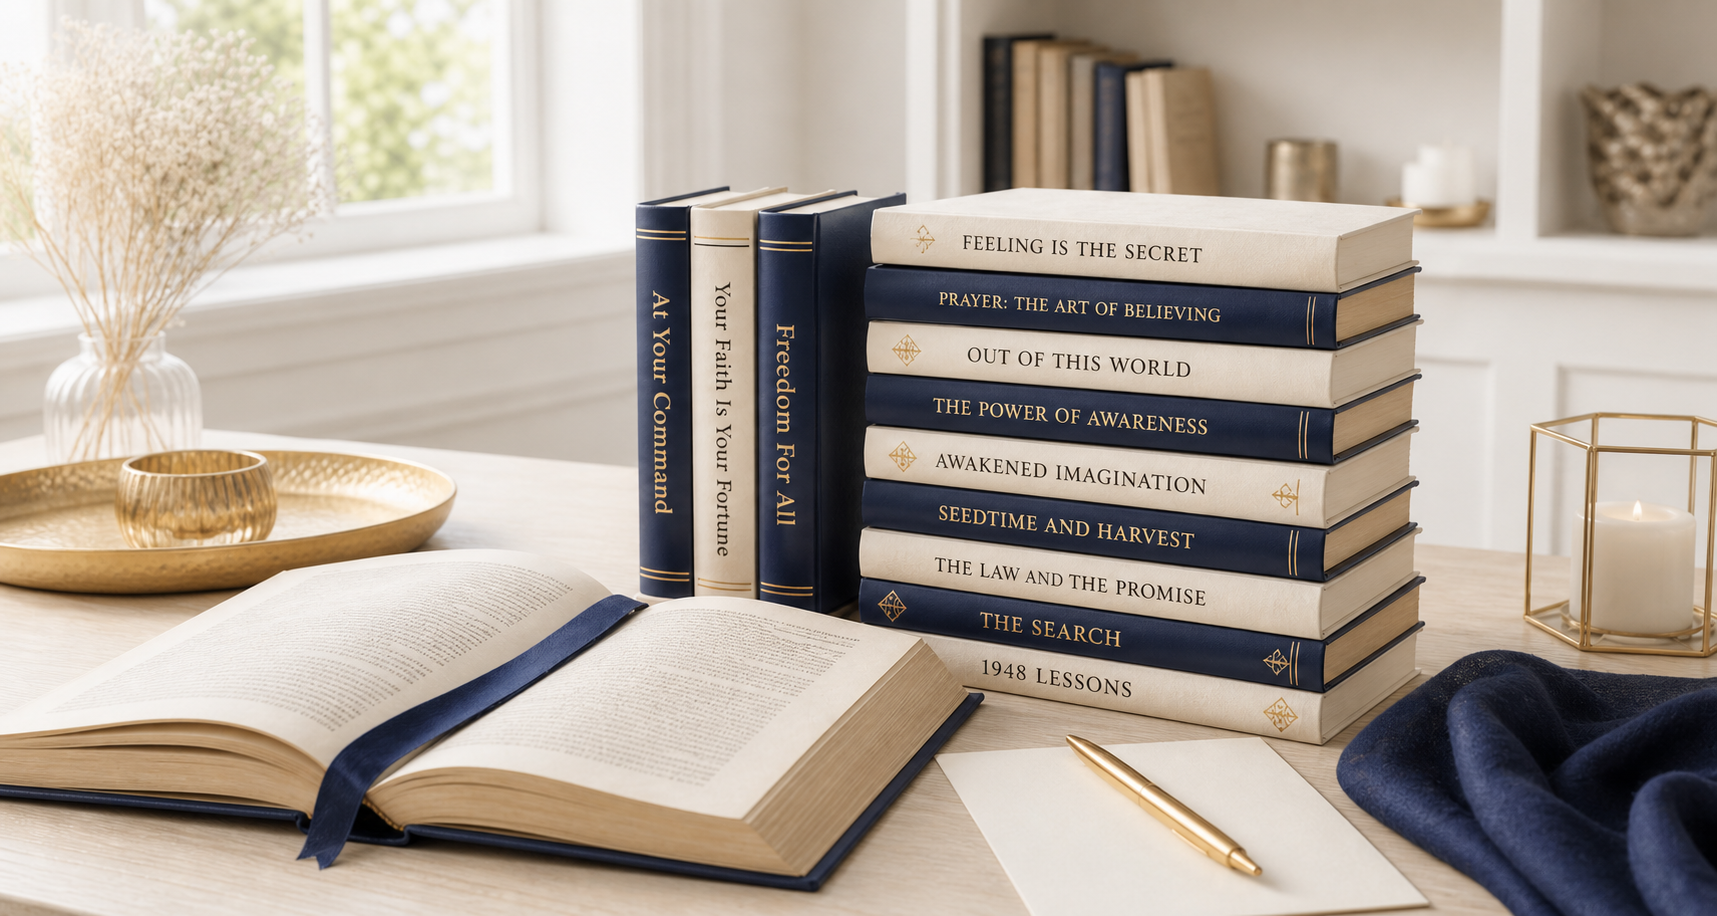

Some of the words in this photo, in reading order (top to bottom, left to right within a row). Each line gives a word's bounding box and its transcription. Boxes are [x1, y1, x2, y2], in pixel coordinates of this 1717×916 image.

[963, 235, 1043, 254] FEELING
[1052, 240, 1067, 255] IS
[1076, 242, 1116, 258] THE
[1125, 244, 1202, 263] SECRET
[653, 290, 669, 319] At
[715, 282, 731, 330] Your
[940, 292, 1007, 309] PRAYER:
[1014, 297, 1048, 311] THE
[1055, 300, 1089, 314] ART
[1095, 302, 1118, 316] OF
[1125, 304, 1220, 322] BELIEVING
[653, 328, 670, 384] Your
[716, 339, 732, 390] Faith
[968, 347, 1010, 364] OUT
[1018, 351, 1044, 367] OF
[1052, 353, 1100, 371] THIS
[1110, 357, 1190, 377] WORLD
[776, 324, 795, 433] Freedom
[716, 400, 731, 416] Is
[933, 398, 971, 415] THE
[979, 402, 1048, 422] POWER
[1055, 408, 1080, 424] OF
[1087, 411, 1207, 435] AWARENESS
[654, 392, 673, 514] Command
[716, 424, 731, 472] Your
[777, 443, 794, 483] For
[936, 454, 1047, 478] AWAKENED
[1056, 465, 1206, 494] IMAGINATION
[717, 480, 731, 556] Fortune
[777, 490, 795, 525] All
[939, 505, 1037, 531] SEEDTIME
[1044, 518, 1089, 536] AND
[1098, 523, 1194, 549] HARVEST
[935, 557, 972, 575] THE
[981, 563, 1020, 581] LAW
[1026, 571, 1063, 586] AND
[1069, 574, 1107, 593] THE
[1117, 580, 1205, 606] PROMISE
[980, 612, 1023, 633] THE
[1032, 620, 1121, 647] SEARCH
[982, 660, 1026, 680] 1948
[1035, 668, 1132, 697] LESSONS
